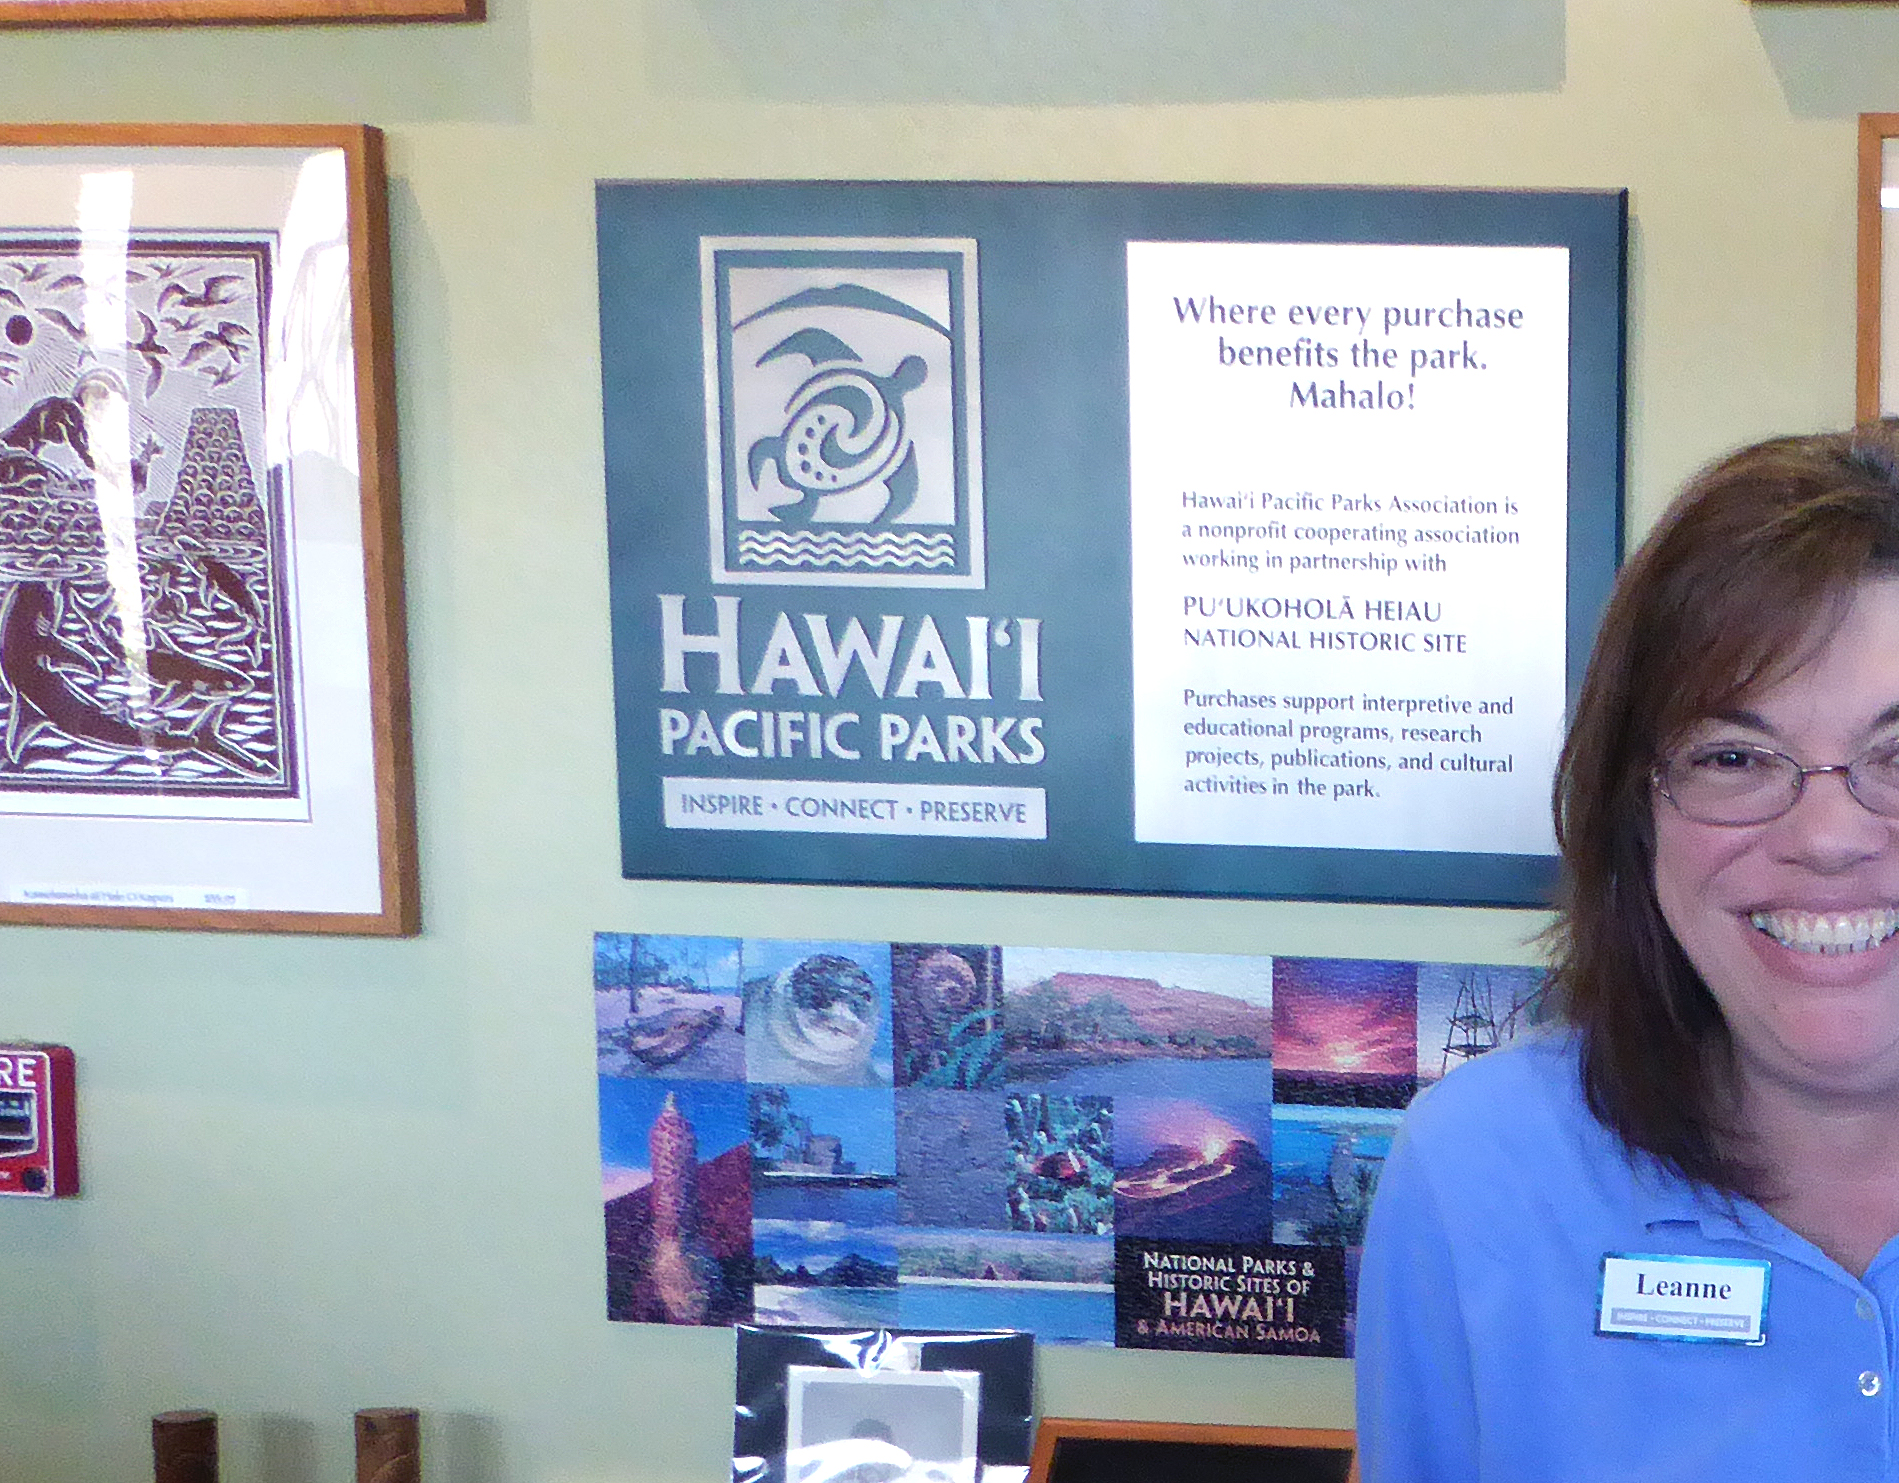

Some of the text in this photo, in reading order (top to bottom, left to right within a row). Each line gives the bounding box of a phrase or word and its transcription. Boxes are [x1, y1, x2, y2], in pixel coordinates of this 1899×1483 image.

[1173, 295, 1523, 335] Where every purchase
[1219, 336, 1486, 377] benefits the park.
[1290, 380, 1413, 409] Mahalo!
[1183, 491, 1518, 514] Hawai'i Pacific Parks Association is
[1182, 521, 1519, 546] a nonprofit cooperating association
[1183, 549, 1446, 576] working in partnership with
[1184, 596, 1440, 622] PU'UKOHOLĀ HEIAU
[656, 595, 1051, 700] HAWAI'I
[1184, 629, 1465, 652] NATIONAL HISTORIC SITE
[1184, 689, 1512, 716] Purchases support interpretive and
[660, 709, 1051, 763] PACIFIC PARKS
[1184, 717, 1481, 744] educational programs, research
[1186, 747, 1512, 772] projects, publications, and cultural
[1184, 775, 1380, 801] activities in the park.
[681, 794, 1026, 823] INSPIRE CONNECT PRESERVE
[1143, 1253, 1315, 1277] NATIONAL PARKS &
[1148, 1271, 1310, 1296] HISTORIC SITES OF
[1637, 1273, 1732, 1300] Leanne
[1164, 1292, 1293, 1321] HAWAI'I
[1137, 1319, 1320, 1342] & AMERICAN SAMOA
